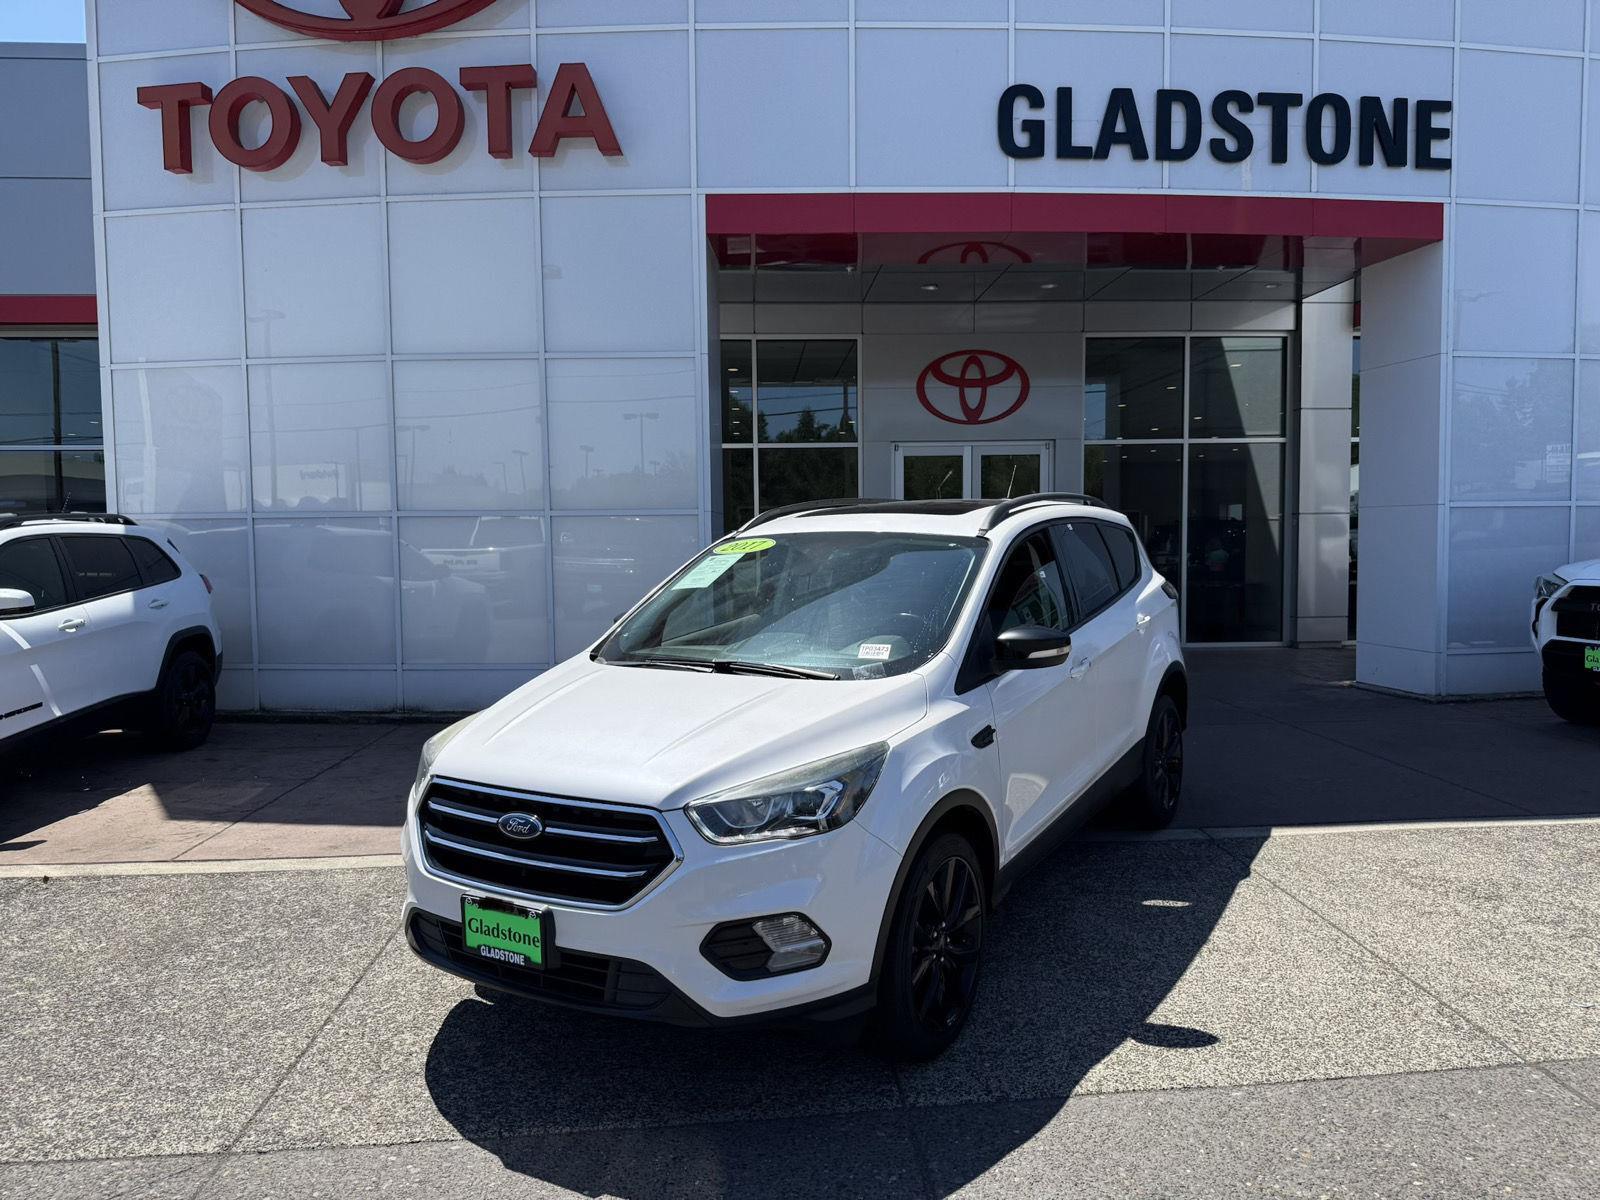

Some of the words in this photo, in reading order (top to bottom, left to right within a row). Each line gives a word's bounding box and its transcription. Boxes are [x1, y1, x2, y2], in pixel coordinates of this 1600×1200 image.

[137, 63, 623, 174] TOYOTA
[998, 84, 1452, 170] GLADSTONE
[506, 818, 531, 834] Ford
[467, 917, 540, 948] Gladstone
[480, 945, 526, 966] GLADSTONE
